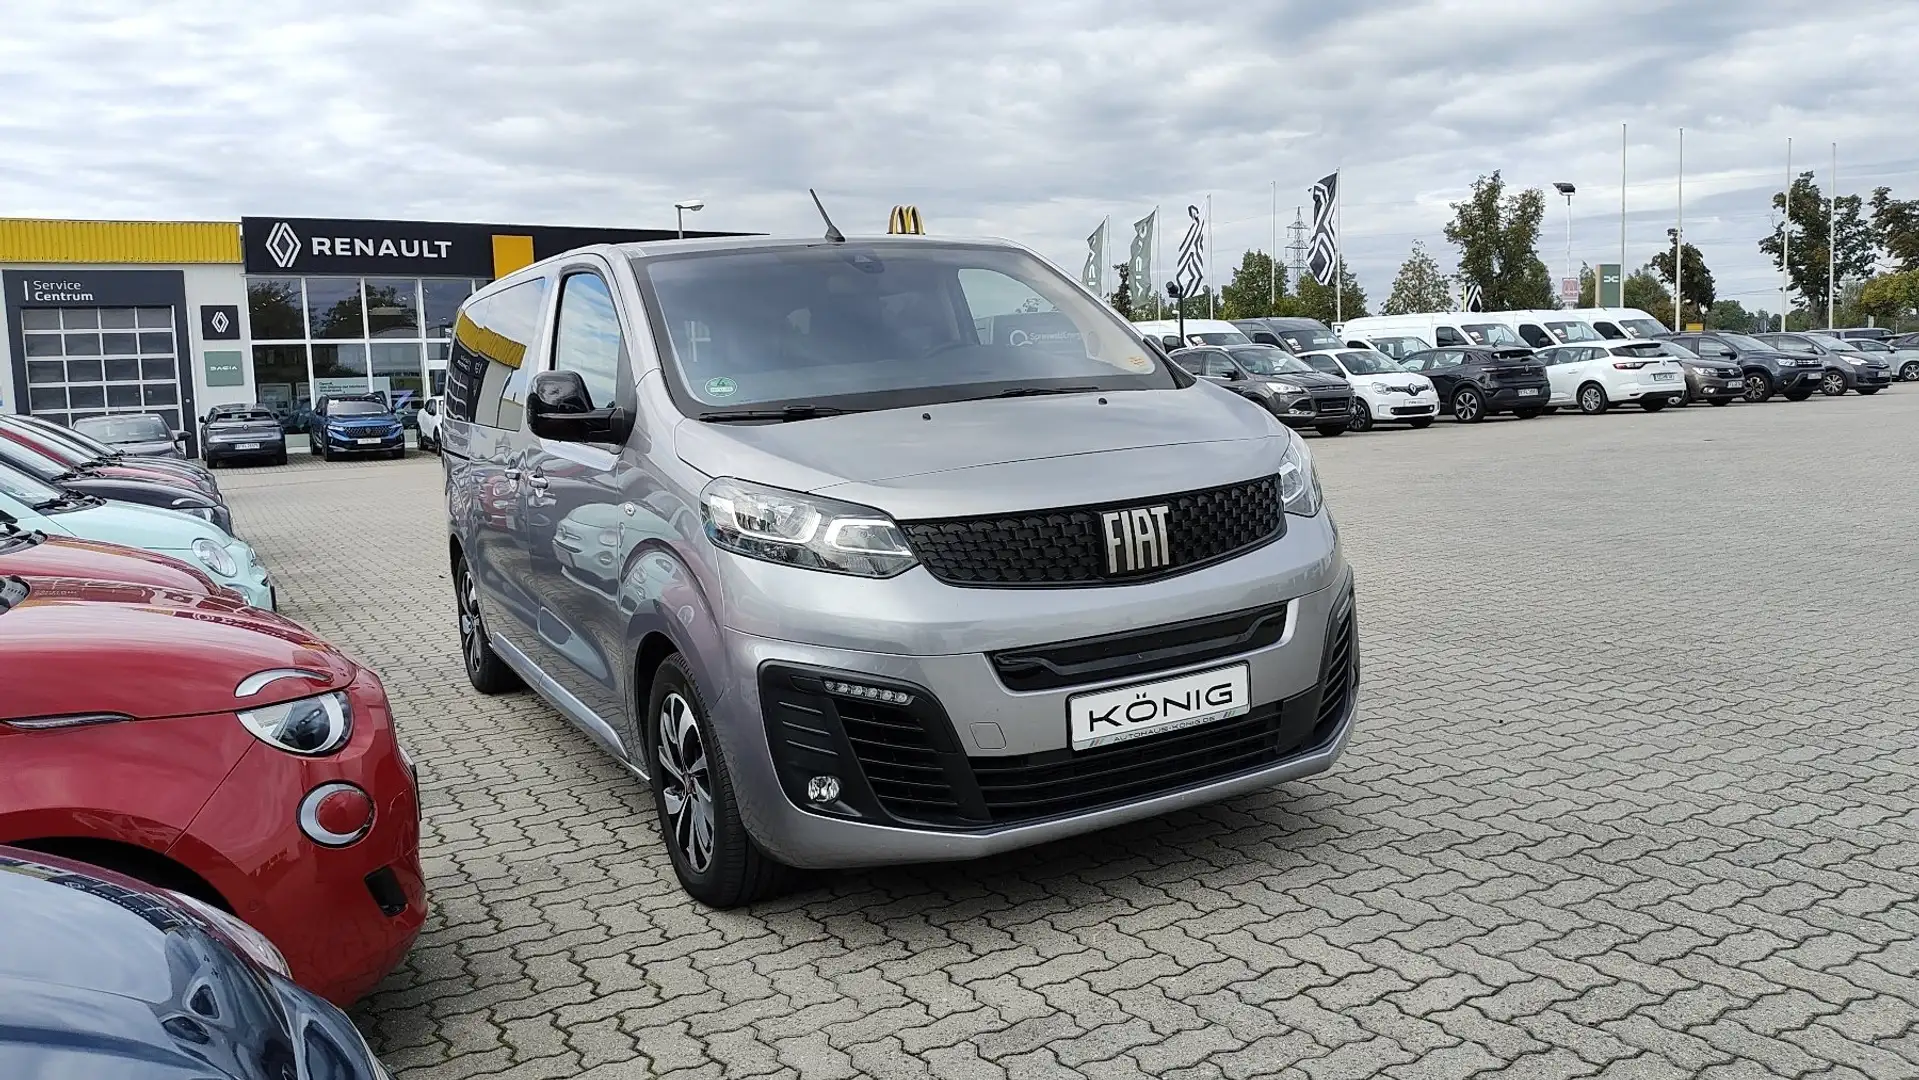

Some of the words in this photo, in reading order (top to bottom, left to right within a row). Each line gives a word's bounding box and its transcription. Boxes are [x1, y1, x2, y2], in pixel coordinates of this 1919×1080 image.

[311, 236, 453, 259] RENAULT
[33, 280, 81, 290] Service
[35, 291, 94, 301] Centrum
[1103, 505, 1170, 574] FIAT
[1089, 683, 1233, 732] KÖNIG
